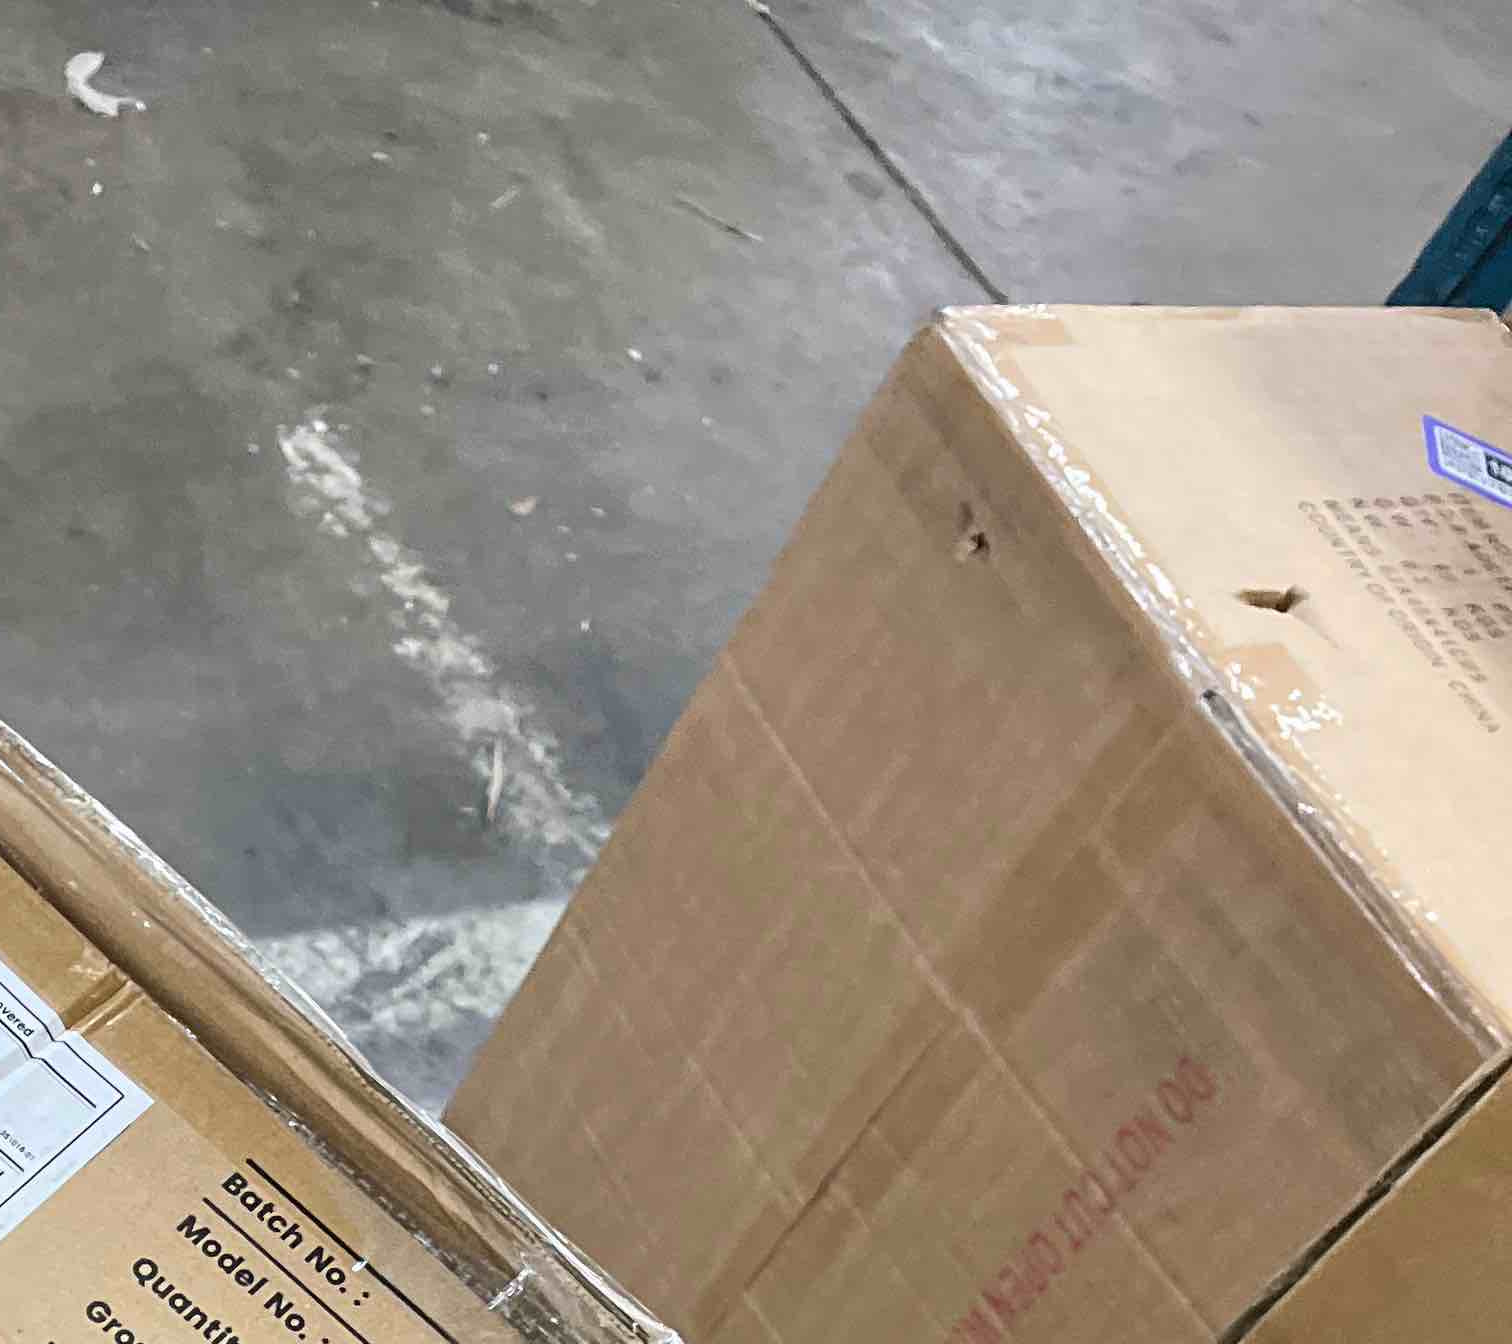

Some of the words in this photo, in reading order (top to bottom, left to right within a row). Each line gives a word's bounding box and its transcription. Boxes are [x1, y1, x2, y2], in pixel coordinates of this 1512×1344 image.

[177, 1215, 268, 1295] Model
[264, 1292, 305, 1340] No.
[222, 1173, 303, 1249] Batch
[305, 1246, 346, 1293] No.
